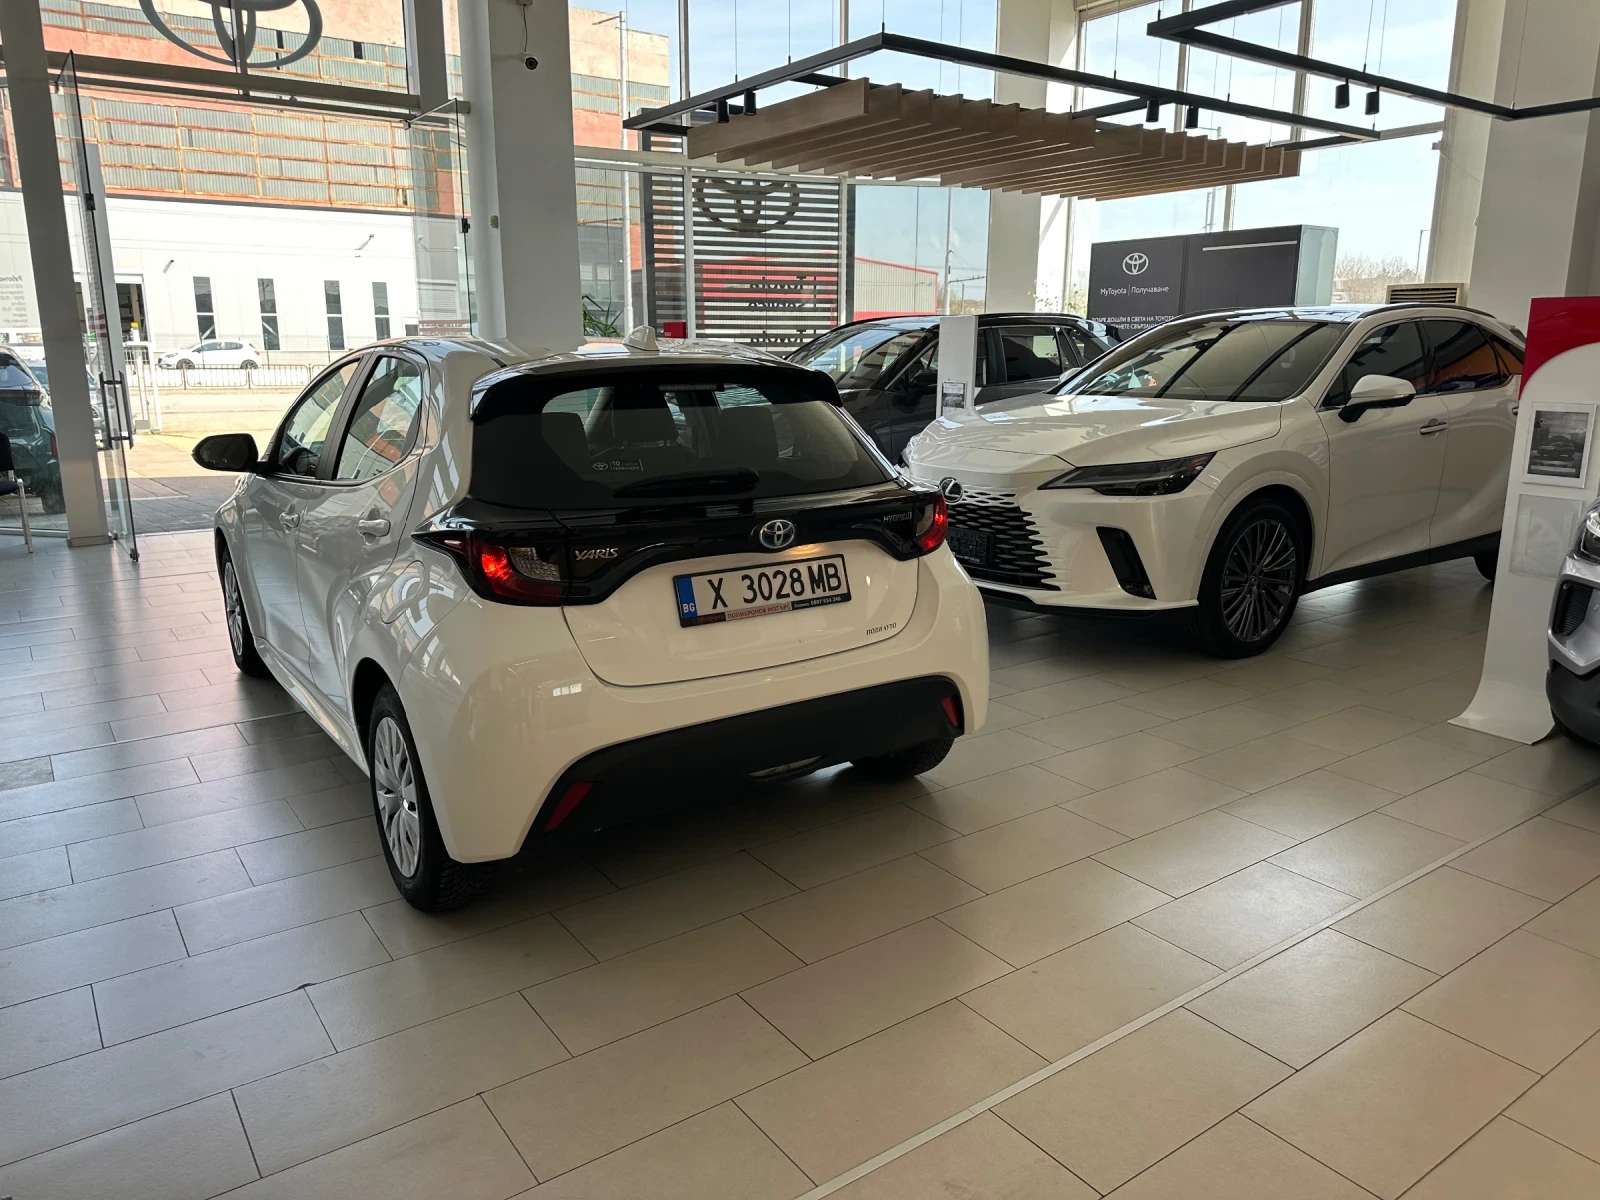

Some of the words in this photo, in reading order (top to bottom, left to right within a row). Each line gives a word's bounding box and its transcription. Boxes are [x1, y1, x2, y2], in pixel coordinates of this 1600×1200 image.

[1100, 287, 1127, 296] MyToyota
[1131, 286, 1169, 294] Получаване
[707, 577, 728, 610] X
[741, 567, 805, 604] 3028
[807, 562, 842, 595] MB
[683, 603, 695, 614] BG
